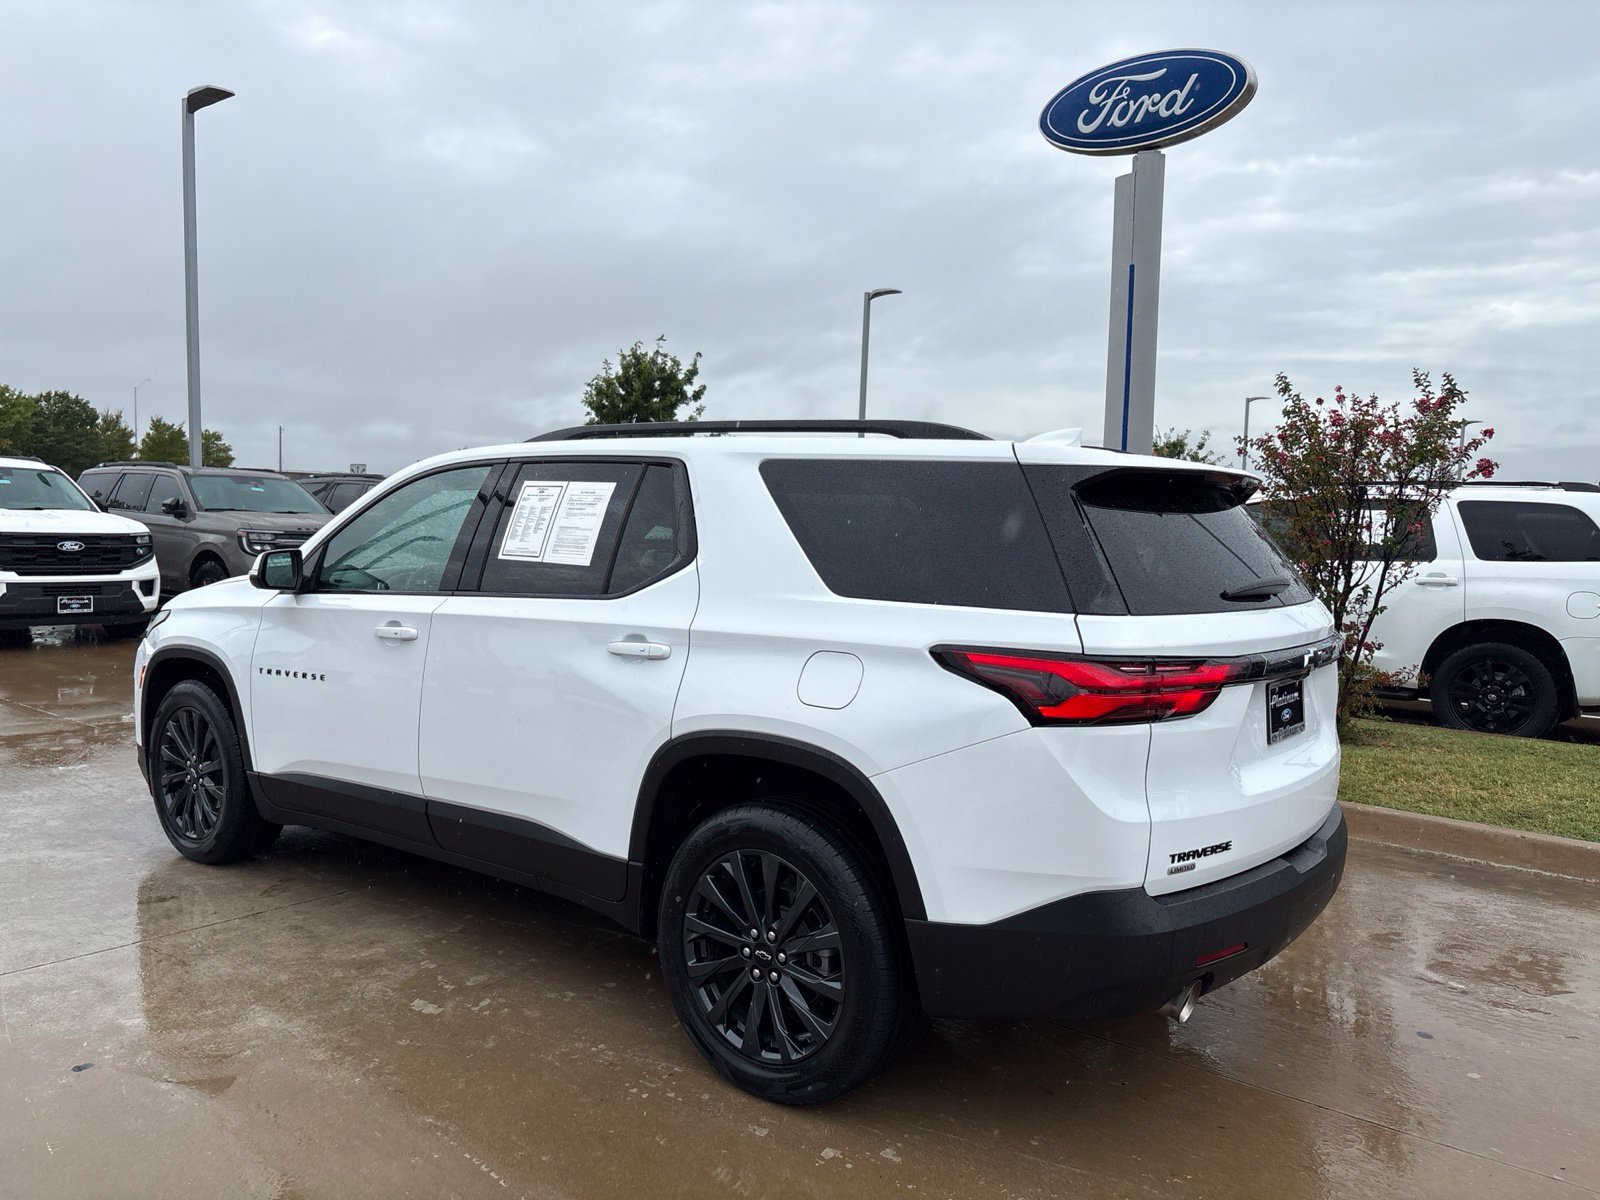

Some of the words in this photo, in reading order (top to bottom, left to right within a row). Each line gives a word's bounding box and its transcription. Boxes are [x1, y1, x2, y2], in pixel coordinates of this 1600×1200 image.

[1077, 67, 1199, 134] Ford
[259, 667, 326, 682] TRAVERSE
[1169, 840, 1232, 864] TRAVERSE
[1167, 862, 1196, 875] LIMITED
